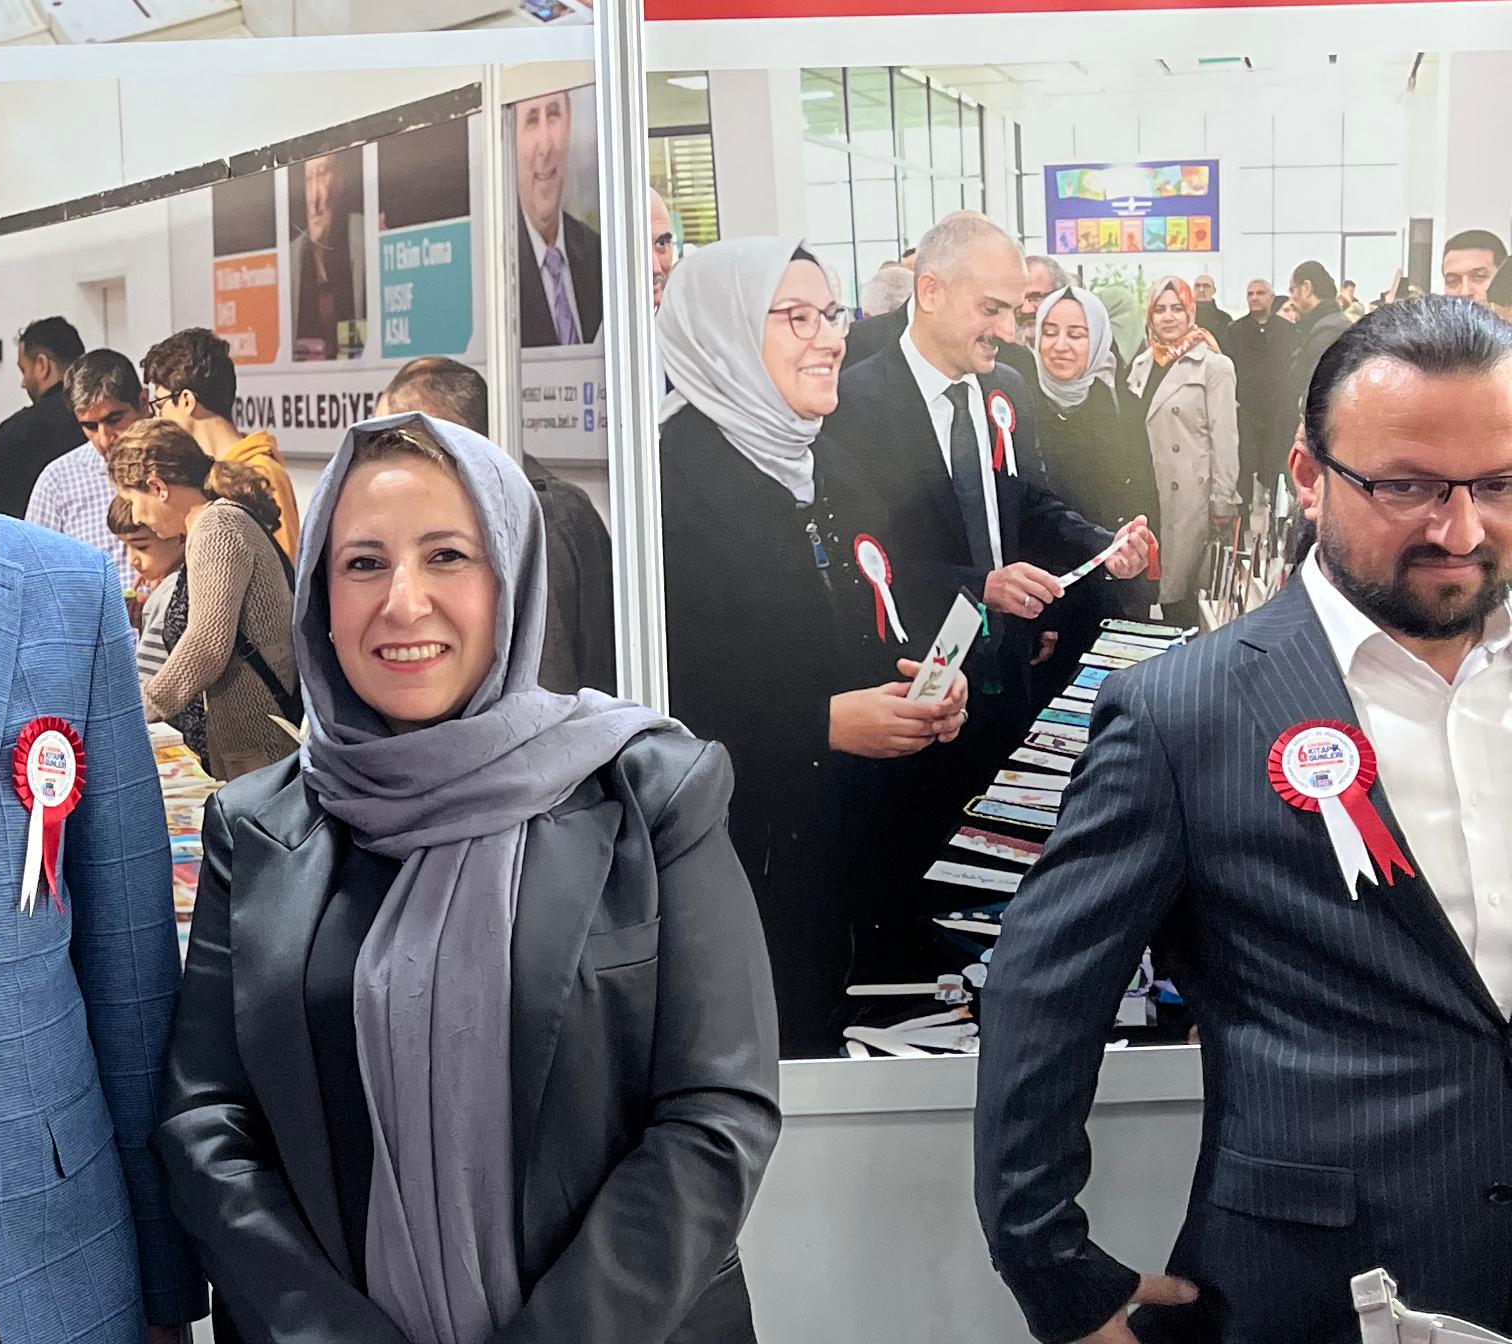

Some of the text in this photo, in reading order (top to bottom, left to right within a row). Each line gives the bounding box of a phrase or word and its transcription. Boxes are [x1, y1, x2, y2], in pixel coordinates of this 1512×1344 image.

[396, 241, 421, 269] Ekim
[423, 238, 452, 267] Cuma
[282, 391, 382, 429] BELEDİYE
